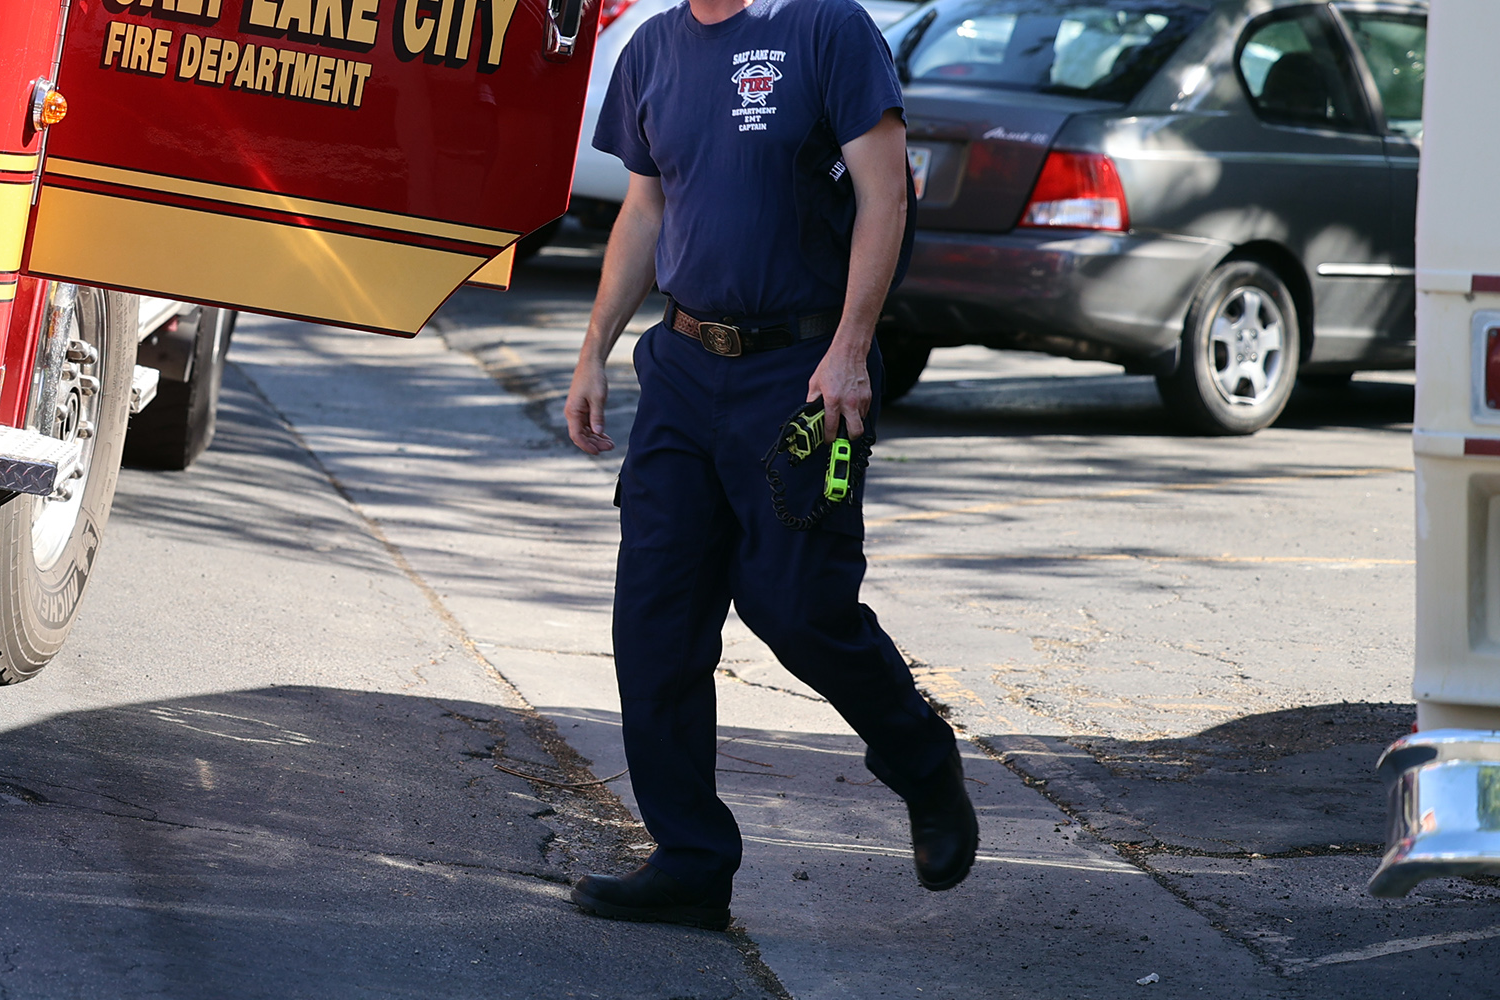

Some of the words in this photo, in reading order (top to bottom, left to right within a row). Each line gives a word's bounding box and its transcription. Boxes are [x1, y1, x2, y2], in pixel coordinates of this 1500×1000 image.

[103, 20, 173, 75] FIRE
[178, 32, 372, 108] DEPARTMENT
[732, 51, 751, 66] SALT
[750, 49, 769, 61] LAKE
[769, 49, 787, 62] CITY
[738, 75, 773, 94] FIRE
[731, 106, 777, 117] DEPARTMENT
[744, 115, 762, 123] EMT
[738, 123, 767, 132] CAPTAIN
[828, 160, 846, 183] CITY
